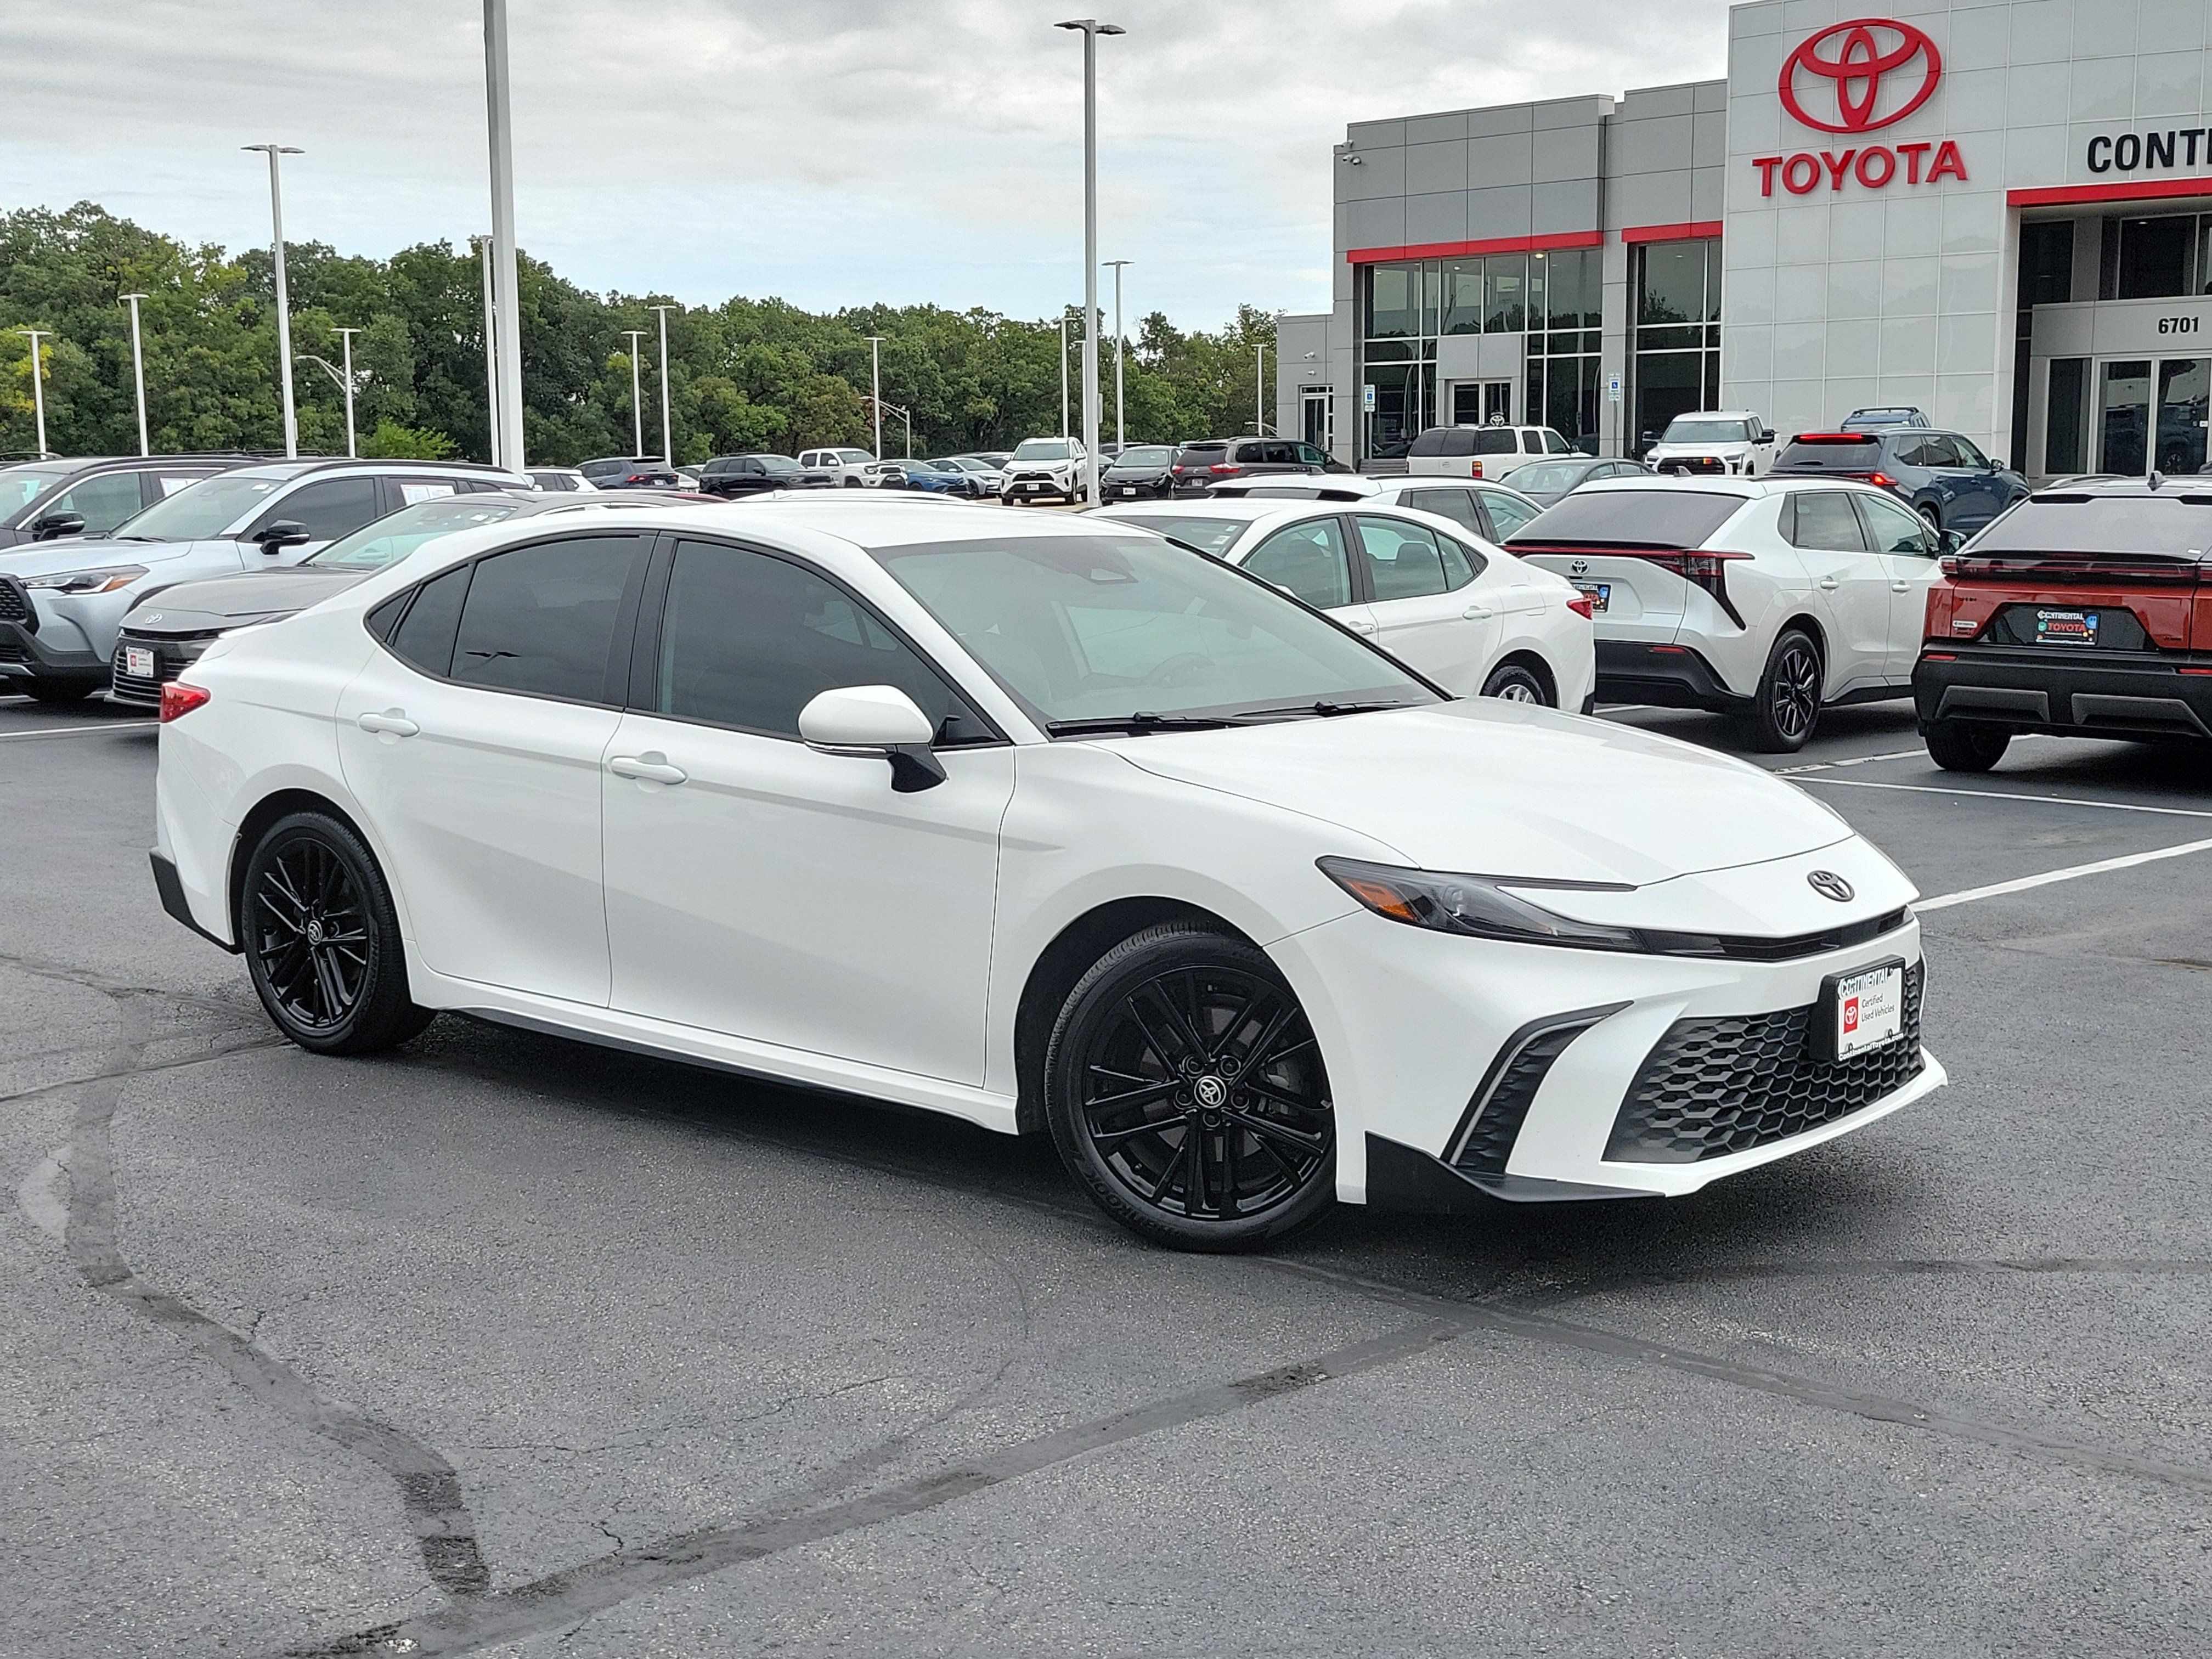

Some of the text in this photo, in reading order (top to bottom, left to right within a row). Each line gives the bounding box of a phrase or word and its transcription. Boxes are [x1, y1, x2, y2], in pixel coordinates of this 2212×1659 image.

[1752, 139, 1968, 197] TOYOTA
[2158, 317, 2200, 334] 6701
[2048, 623, 2086, 632] TOYOTA
[1862, 993, 1883, 1008] Certified
[1861, 1004, 1894, 1022] Used Vehicles
